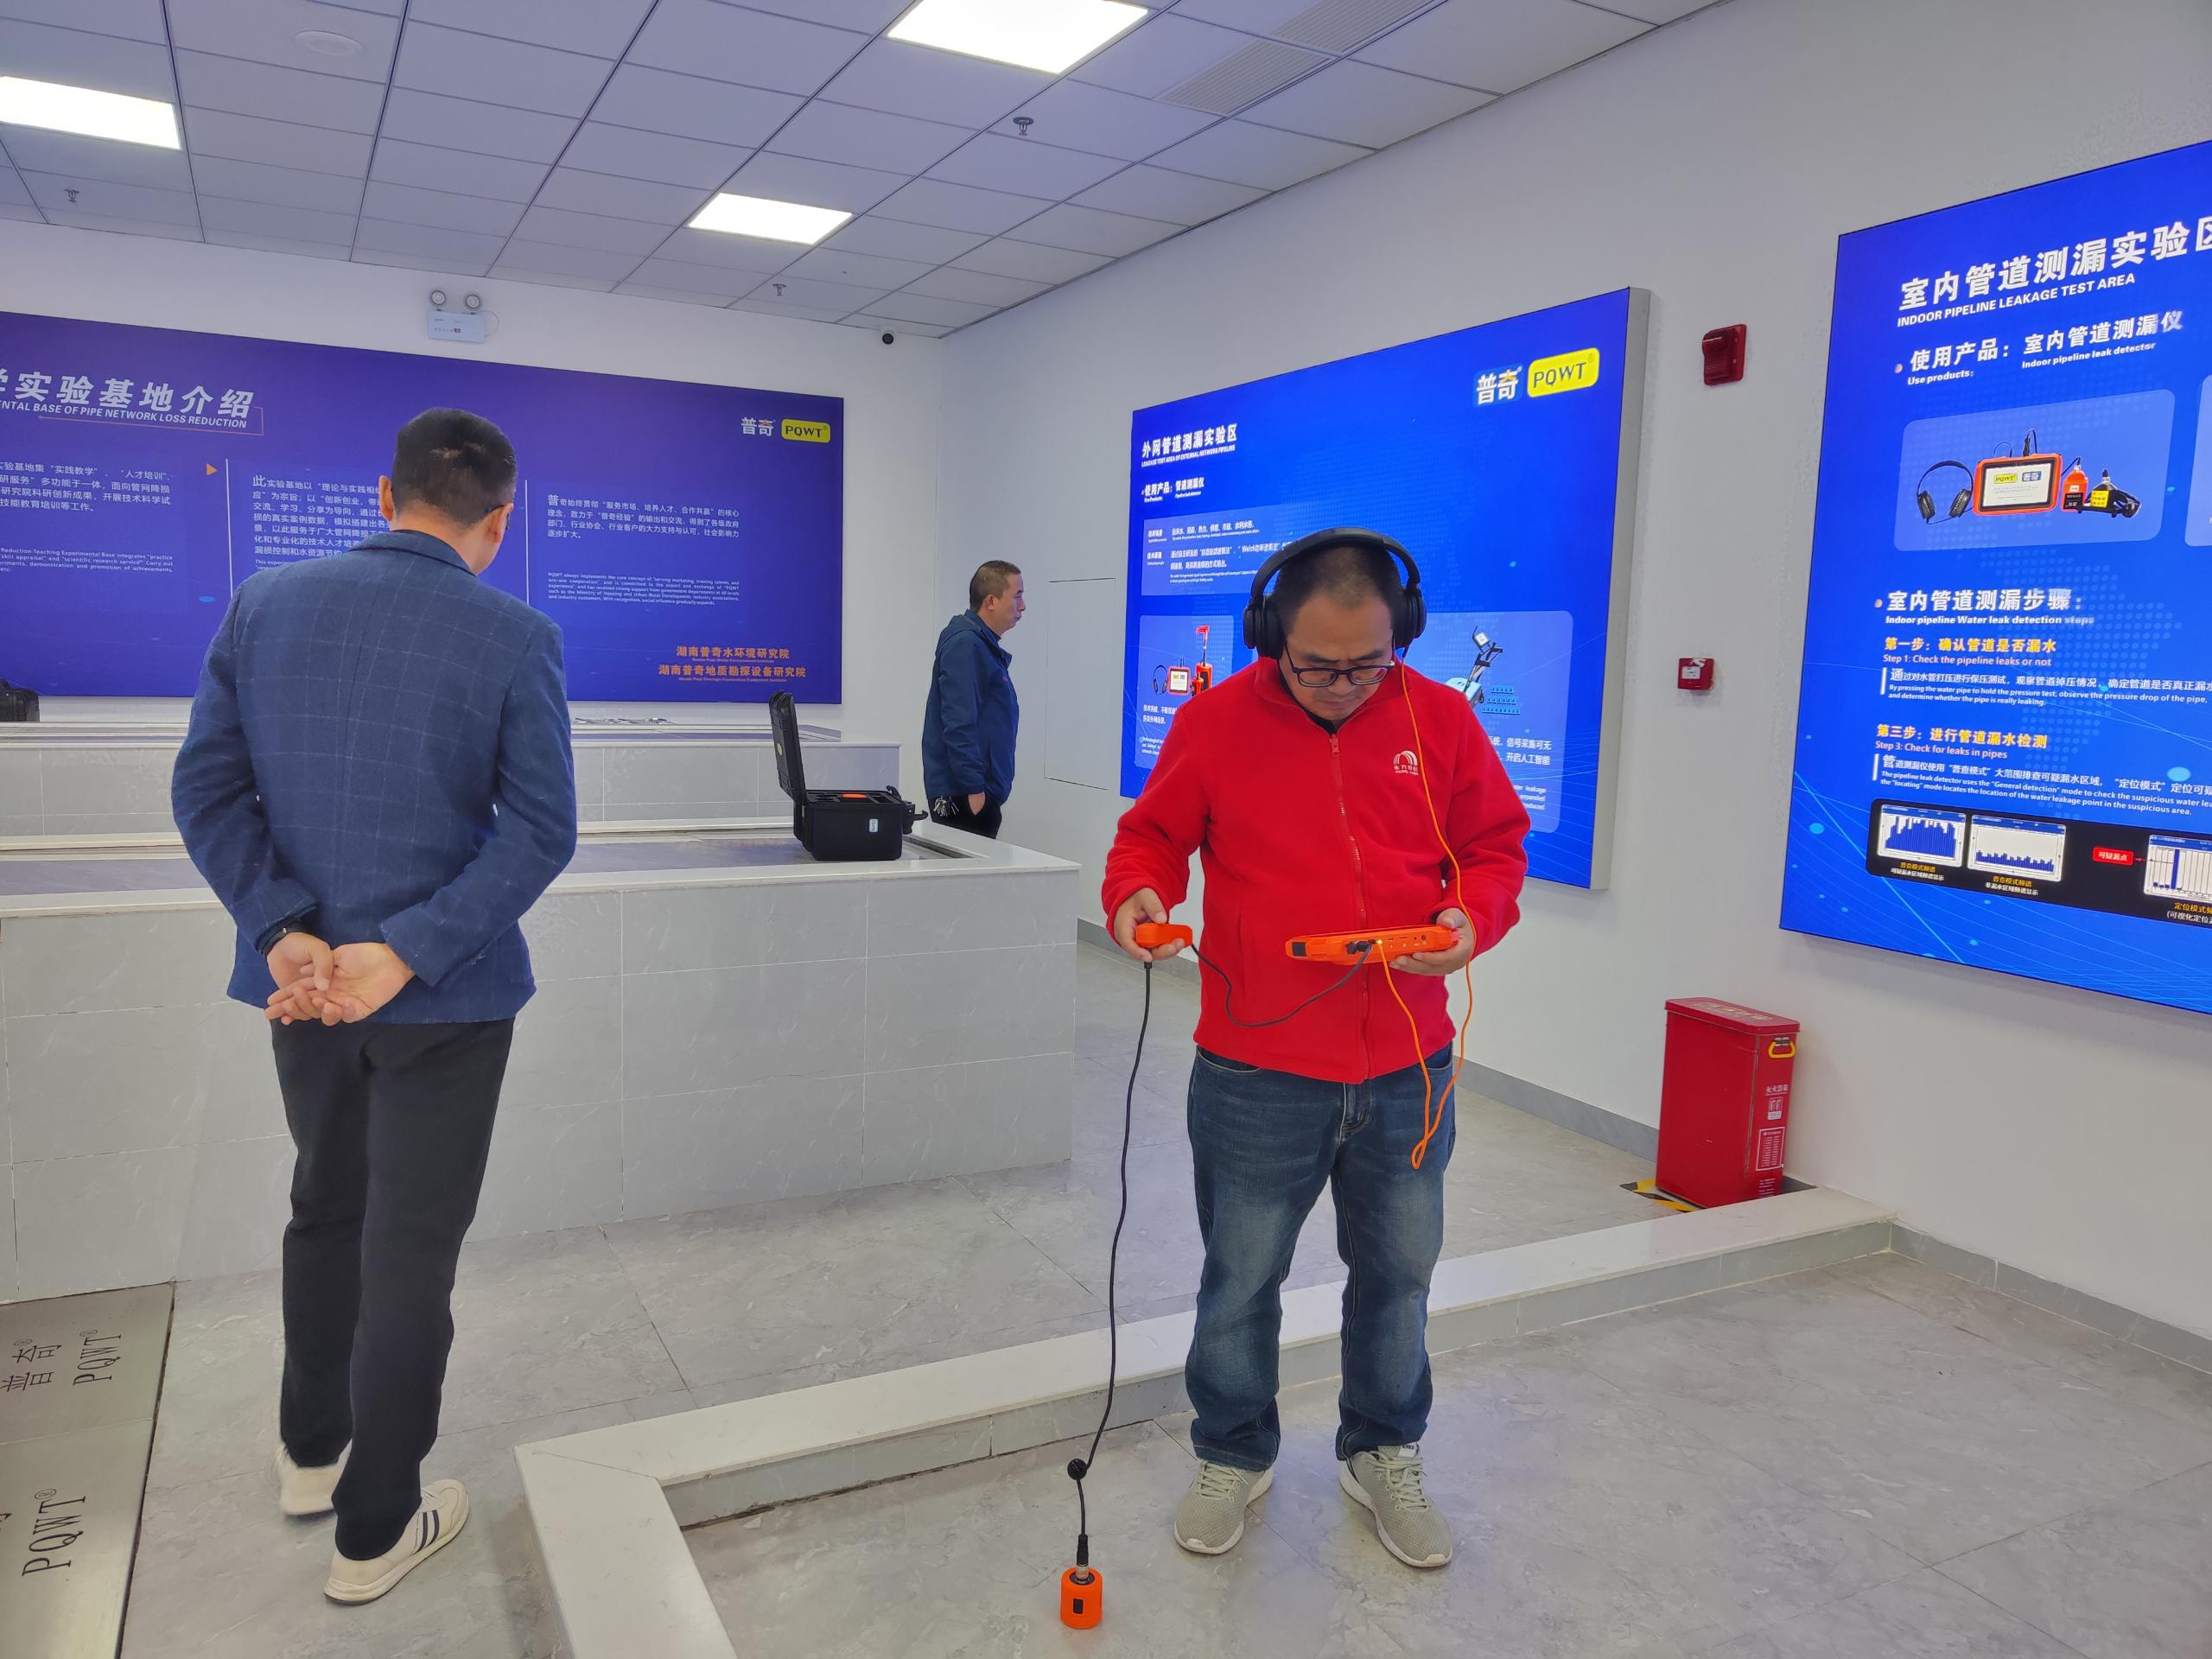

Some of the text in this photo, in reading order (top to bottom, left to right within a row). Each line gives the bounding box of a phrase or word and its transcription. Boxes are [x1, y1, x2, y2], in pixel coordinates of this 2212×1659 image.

[1897, 273, 2134, 327] INDOOR PIPELINE LEAKAGE TEST AREA
[1910, 309, 2183, 372] 使用产品： 室内管道测漏仪
[2022, 341, 2154, 369] Indoor pipeline leak detector
[1477, 369, 1519, 405] 普奇
[1533, 362, 1587, 389] PQWT
[1907, 368, 1974, 385] Use products:
[0, 368, 254, 418] 实验基地介绍
[0, 400, 246, 428] NTAL BASE OF PIPE NETWORK LOSS REDUCTION
[741, 417, 774, 436] 普奇
[785, 425, 823, 438] PQWT
[1141, 423, 1237, 459] 外网管道测漏实验区
[1886, 588, 2082, 612] 室内管道测漏步骤：
[1916, 616, 1955, 625] pipeline
[2064, 616, 2094, 625] steps
[677, 645, 790, 659] 湖南普奇水环境研究院
[1884, 637, 2056, 654] 第一步：确认管道是否漏水
[1884, 654, 1901, 664] Step
[1912, 655, 1937, 664] Check
[1957, 656, 1993, 666] pipeline
[1897, 684, 1924, 693] pressing
[2139, 694, 2158, 702] drop
[2186, 696, 2207, 704] pipe,
[2018, 698, 2046, 707] leaking.
[1876, 723, 2048, 750] 第三步：进行管道漏水检测
[1875, 741, 1893, 752] Step
[1904, 743, 1930, 753] Check
[1932, 745, 1944, 753] for
[1947, 746, 1969, 755] leaks
[1971, 747, 1980, 756] in
[1981, 748, 2007, 760] pipes
[73, 1333, 122, 1386] PQWT
[22, 1495, 86, 1577] PQWT
